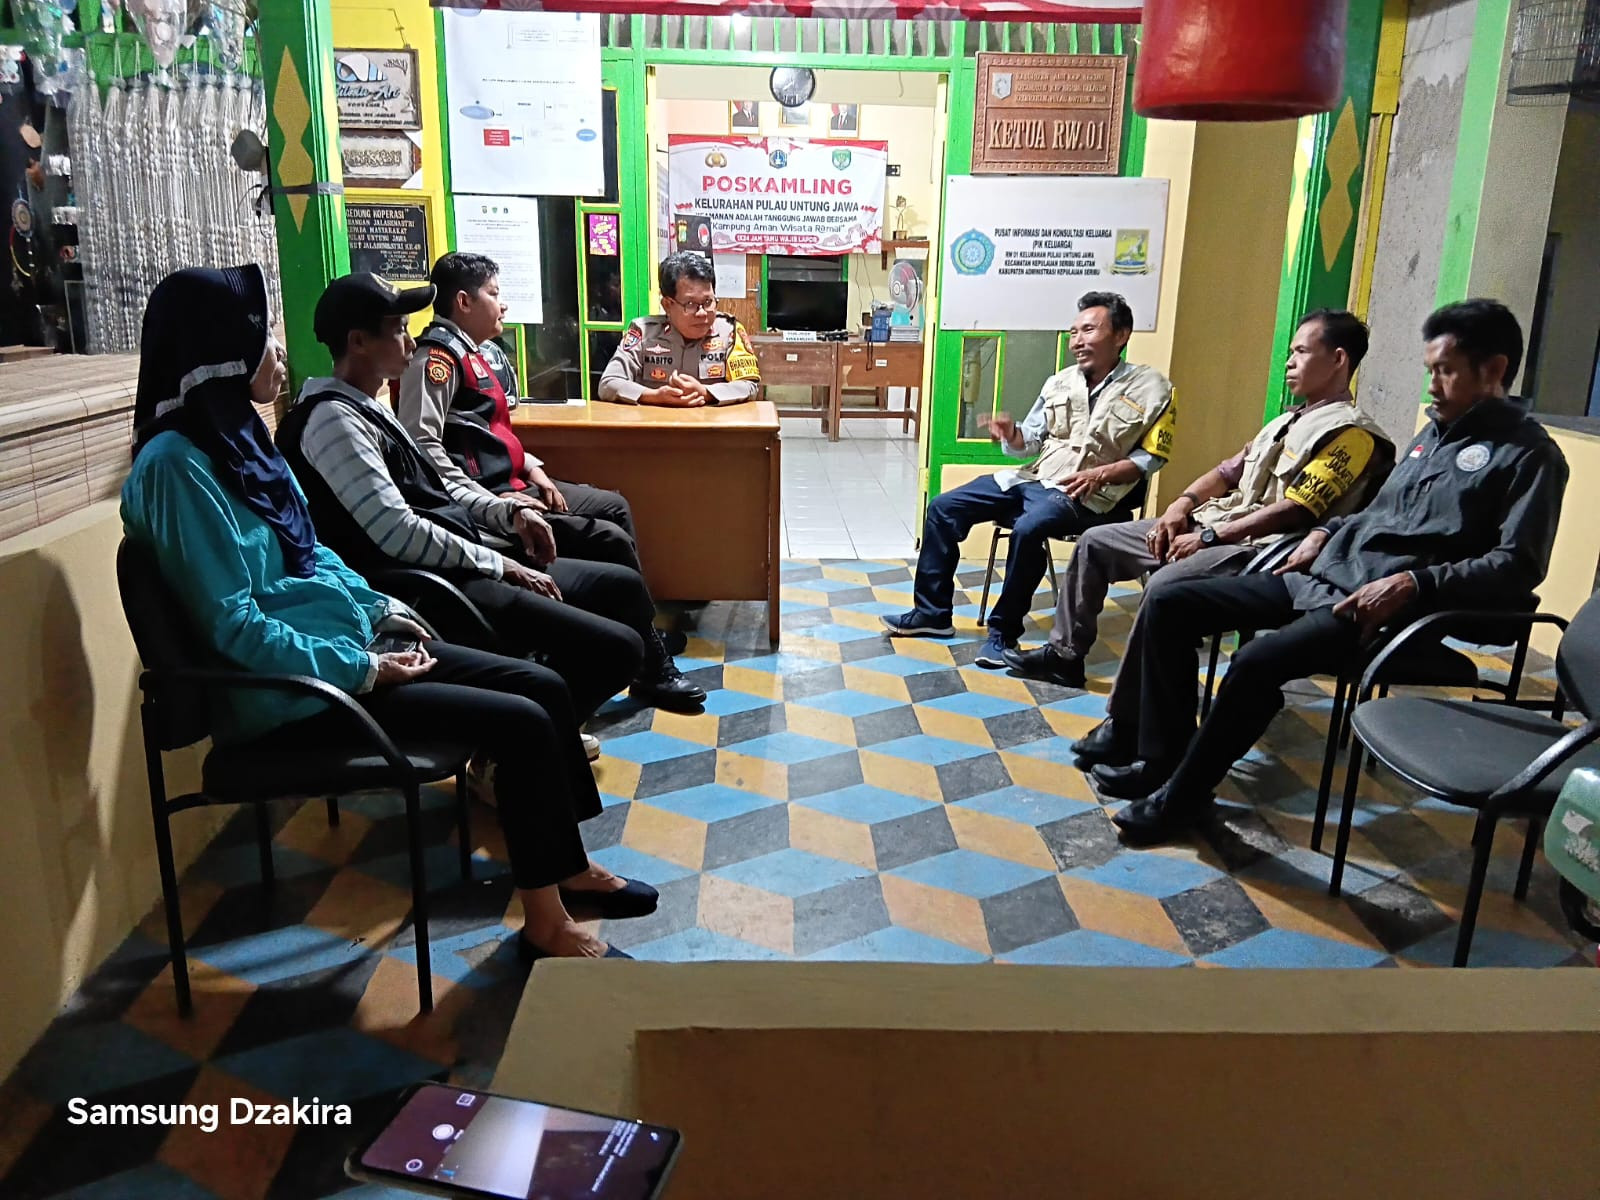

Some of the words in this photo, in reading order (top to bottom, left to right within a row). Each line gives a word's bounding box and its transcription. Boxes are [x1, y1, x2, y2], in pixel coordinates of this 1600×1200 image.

[988, 119, 1046, 150] KETUA
[1052, 120, 1106, 150] RW.01
[702, 175, 852, 195] POSKAMLING
[694, 198, 753, 211] KELURAHAN
[756, 199, 787, 211] PULAU
[790, 200, 830, 212] UNTUNG
[832, 201, 859, 212] JAWA
[736, 213, 763, 221] ADALAH
[764, 214, 801, 222] TANGGUNG
[802, 215, 825, 223] JAWAB
[827, 215, 857, 223] BERSAMA
[753, 223, 778, 231] Aman
[780, 223, 813, 232] Wisata
[994, 228, 1012, 237] PUSAT
[1013, 228, 1040, 237] INFORMASI
[1041, 228, 1052, 237] DAN
[1053, 228, 1084, 238] KONSULTASI
[1085, 229, 1112, 238] KELUARGA
[1033, 240, 1043, 250] (PIK
[1044, 240, 1073, 250] KELUARGA)
[1084, 268, 1101, 276] SERIBU
[1327, 445, 1352, 465] JAGA
